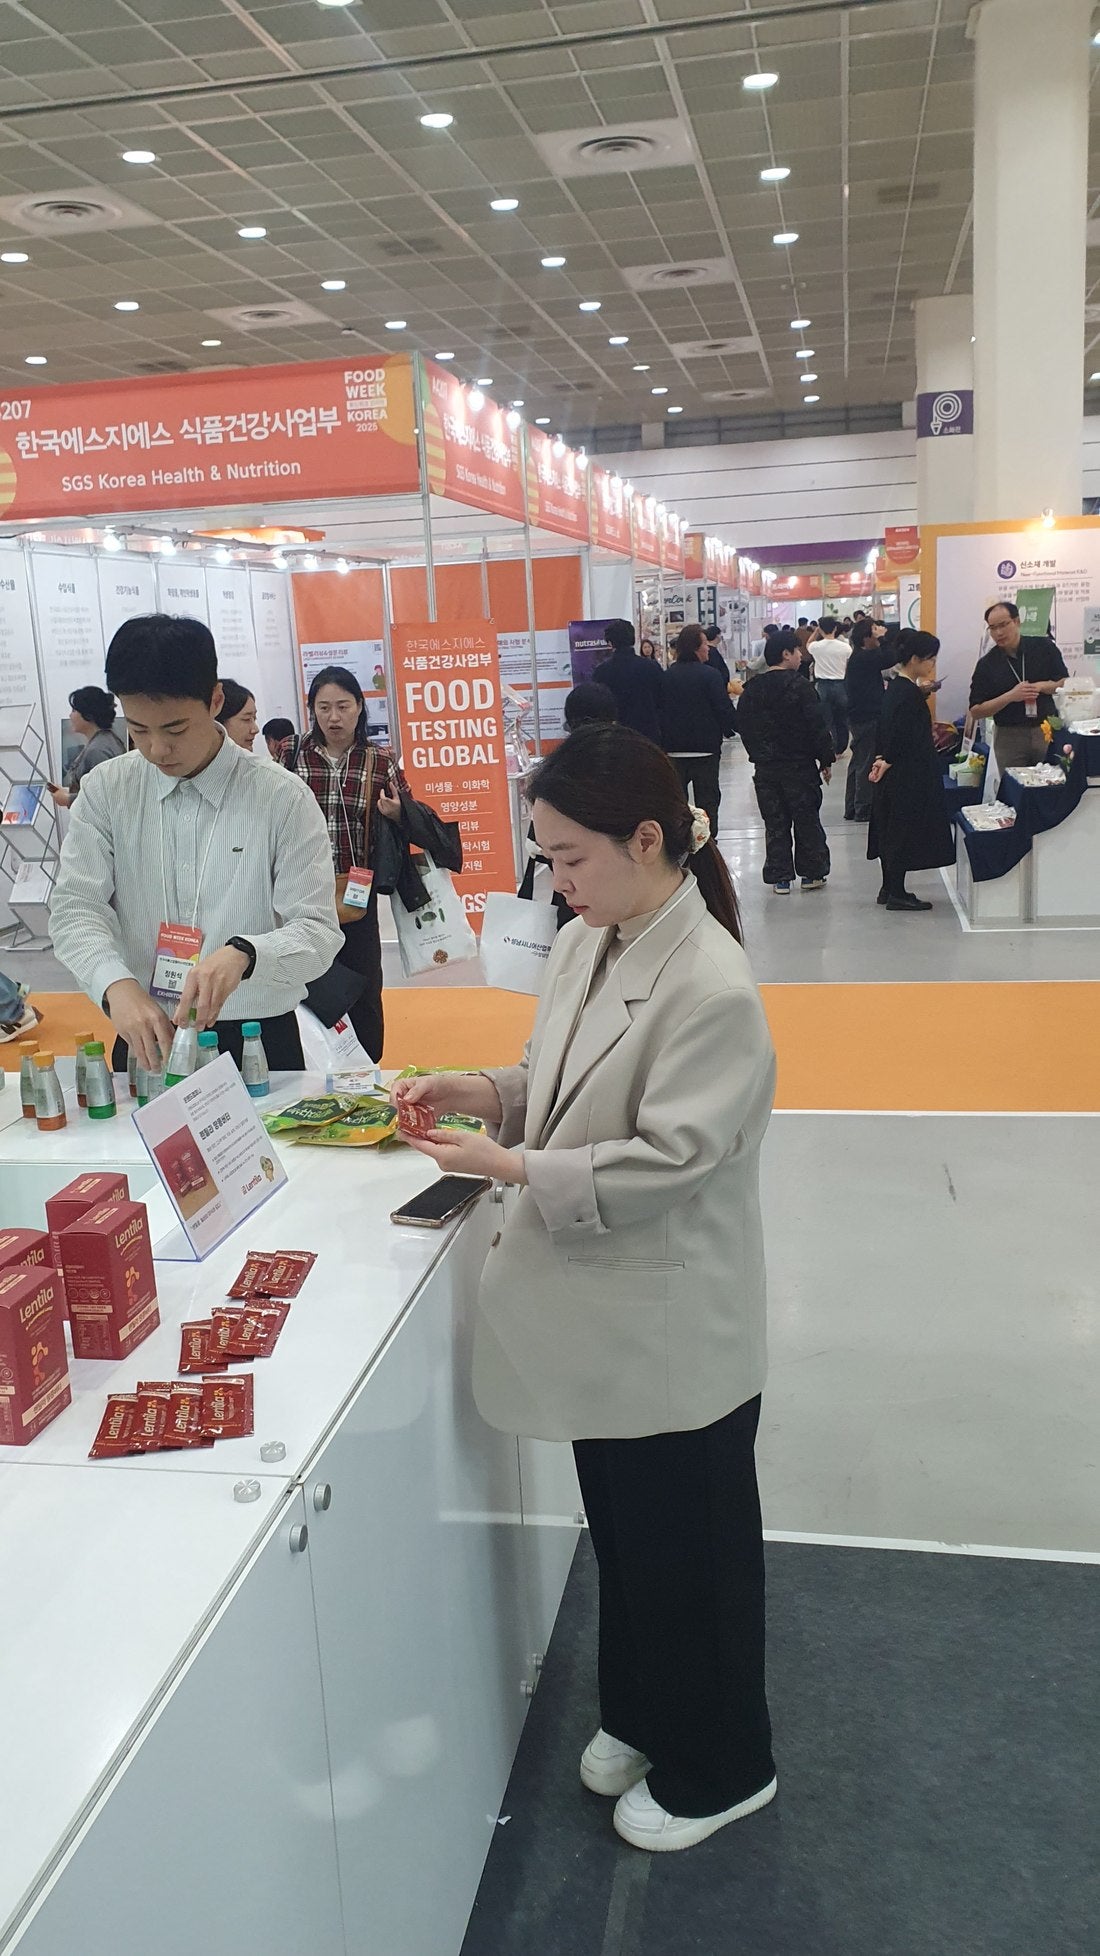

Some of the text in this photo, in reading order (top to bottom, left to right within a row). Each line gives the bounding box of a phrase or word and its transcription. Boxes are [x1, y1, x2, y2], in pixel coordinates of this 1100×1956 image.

[344, 368, 386, 384] FOOD
[345, 382, 387, 399] WEEK
[0, 400, 31, 420] 207
[347, 408, 388, 423] KOREA
[16, 406, 341, 459] 한국에스지에스 식품건강사업부
[356, 422, 379, 432] 2025
[62, 460, 301, 492] SGS Korea Health & Nutrition
[406, 637, 486, 653] 한국에스지에스
[403, 652, 493, 671] 식품건강사업부
[405, 679, 495, 714] FOOD
[407, 717, 497, 741] TESTING
[412, 743, 500, 768] GLOBAL
[425, 781, 453, 794] 미생물
[462, 779, 490, 791] 이화학
[440, 800, 478, 813] 영양성분
[458, 821, 479, 832] 리뷰
[462, 840, 490, 852] 탁시험
[462, 860, 483, 872] 지원
[461, 892, 487, 913] GS
[157, 990, 182, 999] EXHIBITO
[115, 1217, 143, 1249] Lentila
[20, 1286, 54, 1323] Lentila
[174, 1403, 190, 1433] Lentila
[211, 1395, 225, 1421] Lentila
[105, 1410, 124, 1439] Lentila
[141, 1408, 158, 1437] Lentila
